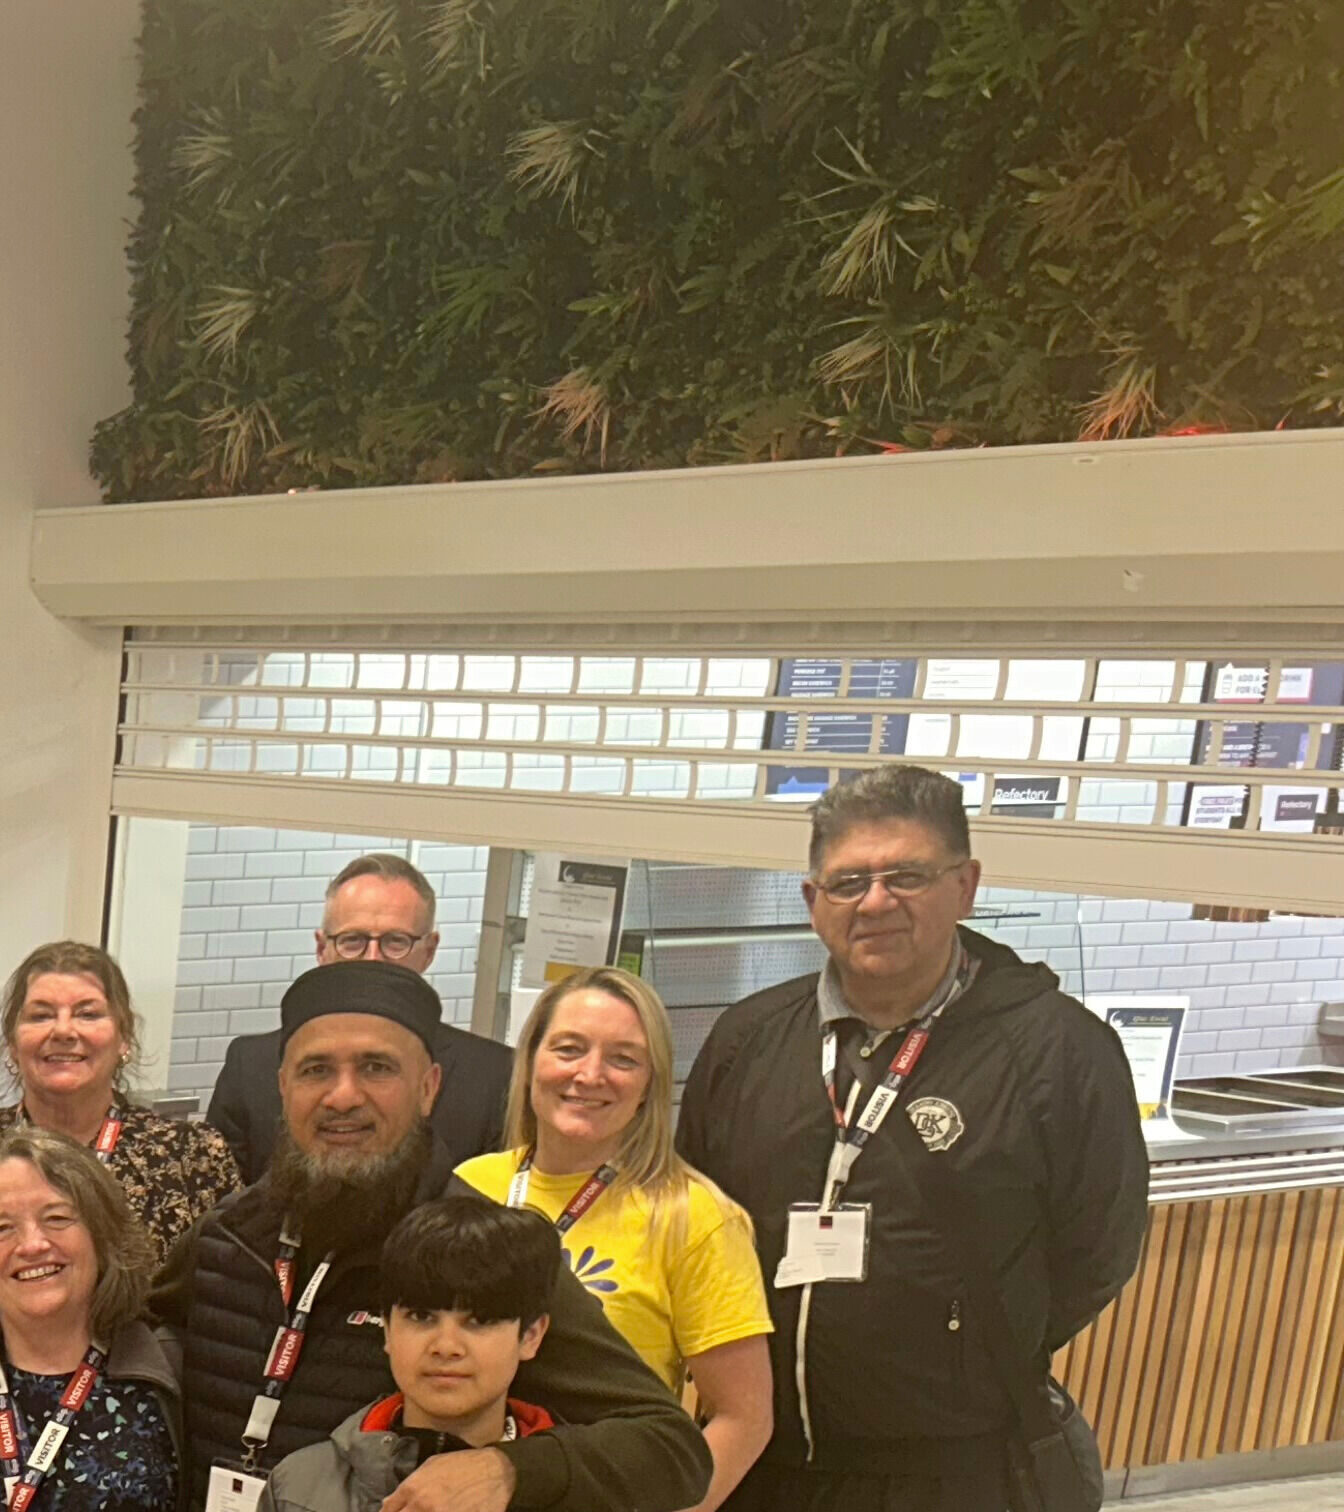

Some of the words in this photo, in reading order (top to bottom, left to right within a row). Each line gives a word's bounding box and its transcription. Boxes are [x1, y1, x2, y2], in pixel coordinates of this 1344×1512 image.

[995, 788, 1049, 801] Refectory
[896, 1033, 923, 1069] VISITOR
[864, 1093, 890, 1128] VISITOR
[569, 1182, 600, 1213] VISITOR
[274, 1334, 298, 1376] VISITOR
[66, 1370, 92, 1405] VISITOR
[35, 1428, 61, 1465] VISITOR
